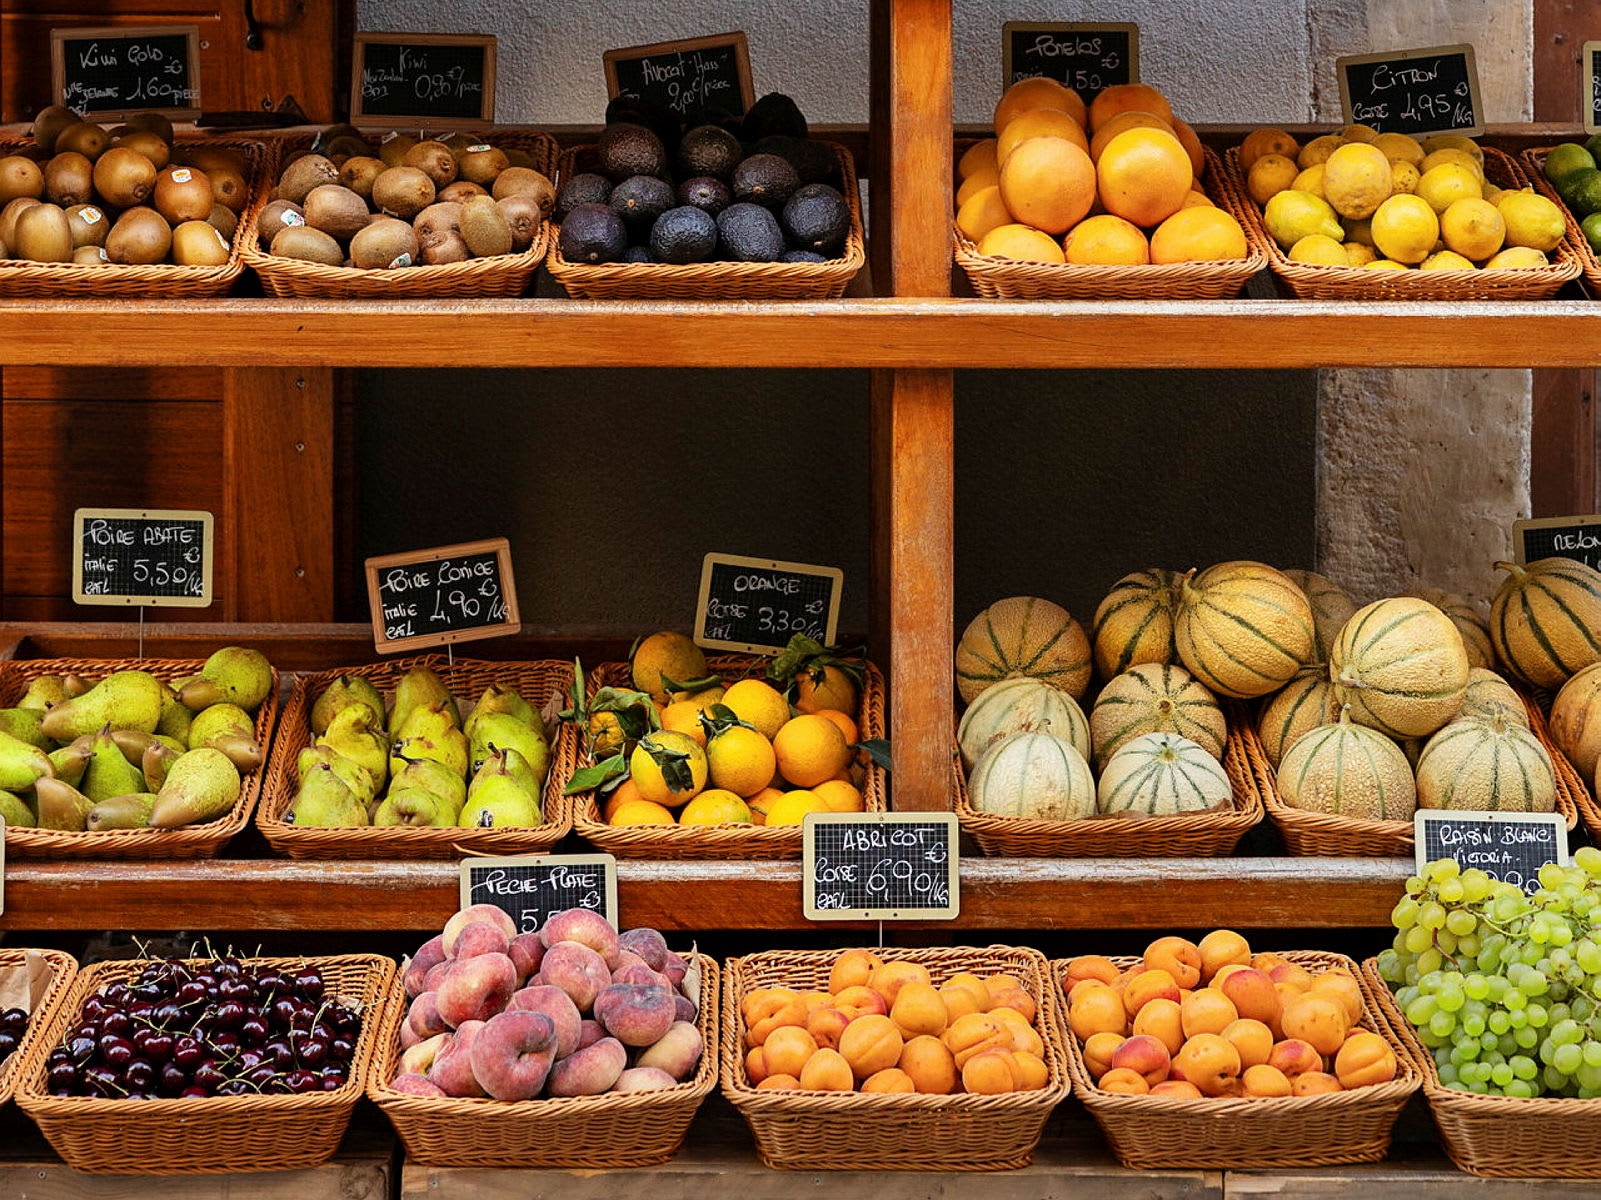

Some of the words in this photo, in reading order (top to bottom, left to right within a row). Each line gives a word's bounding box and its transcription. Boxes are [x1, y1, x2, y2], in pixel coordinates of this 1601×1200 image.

[143, 526, 197, 546] ABATE
[733, 574, 801, 596] ORANGE
[1500, 825, 1552, 846] BLANC
[540, 865, 598, 891] PLATE
